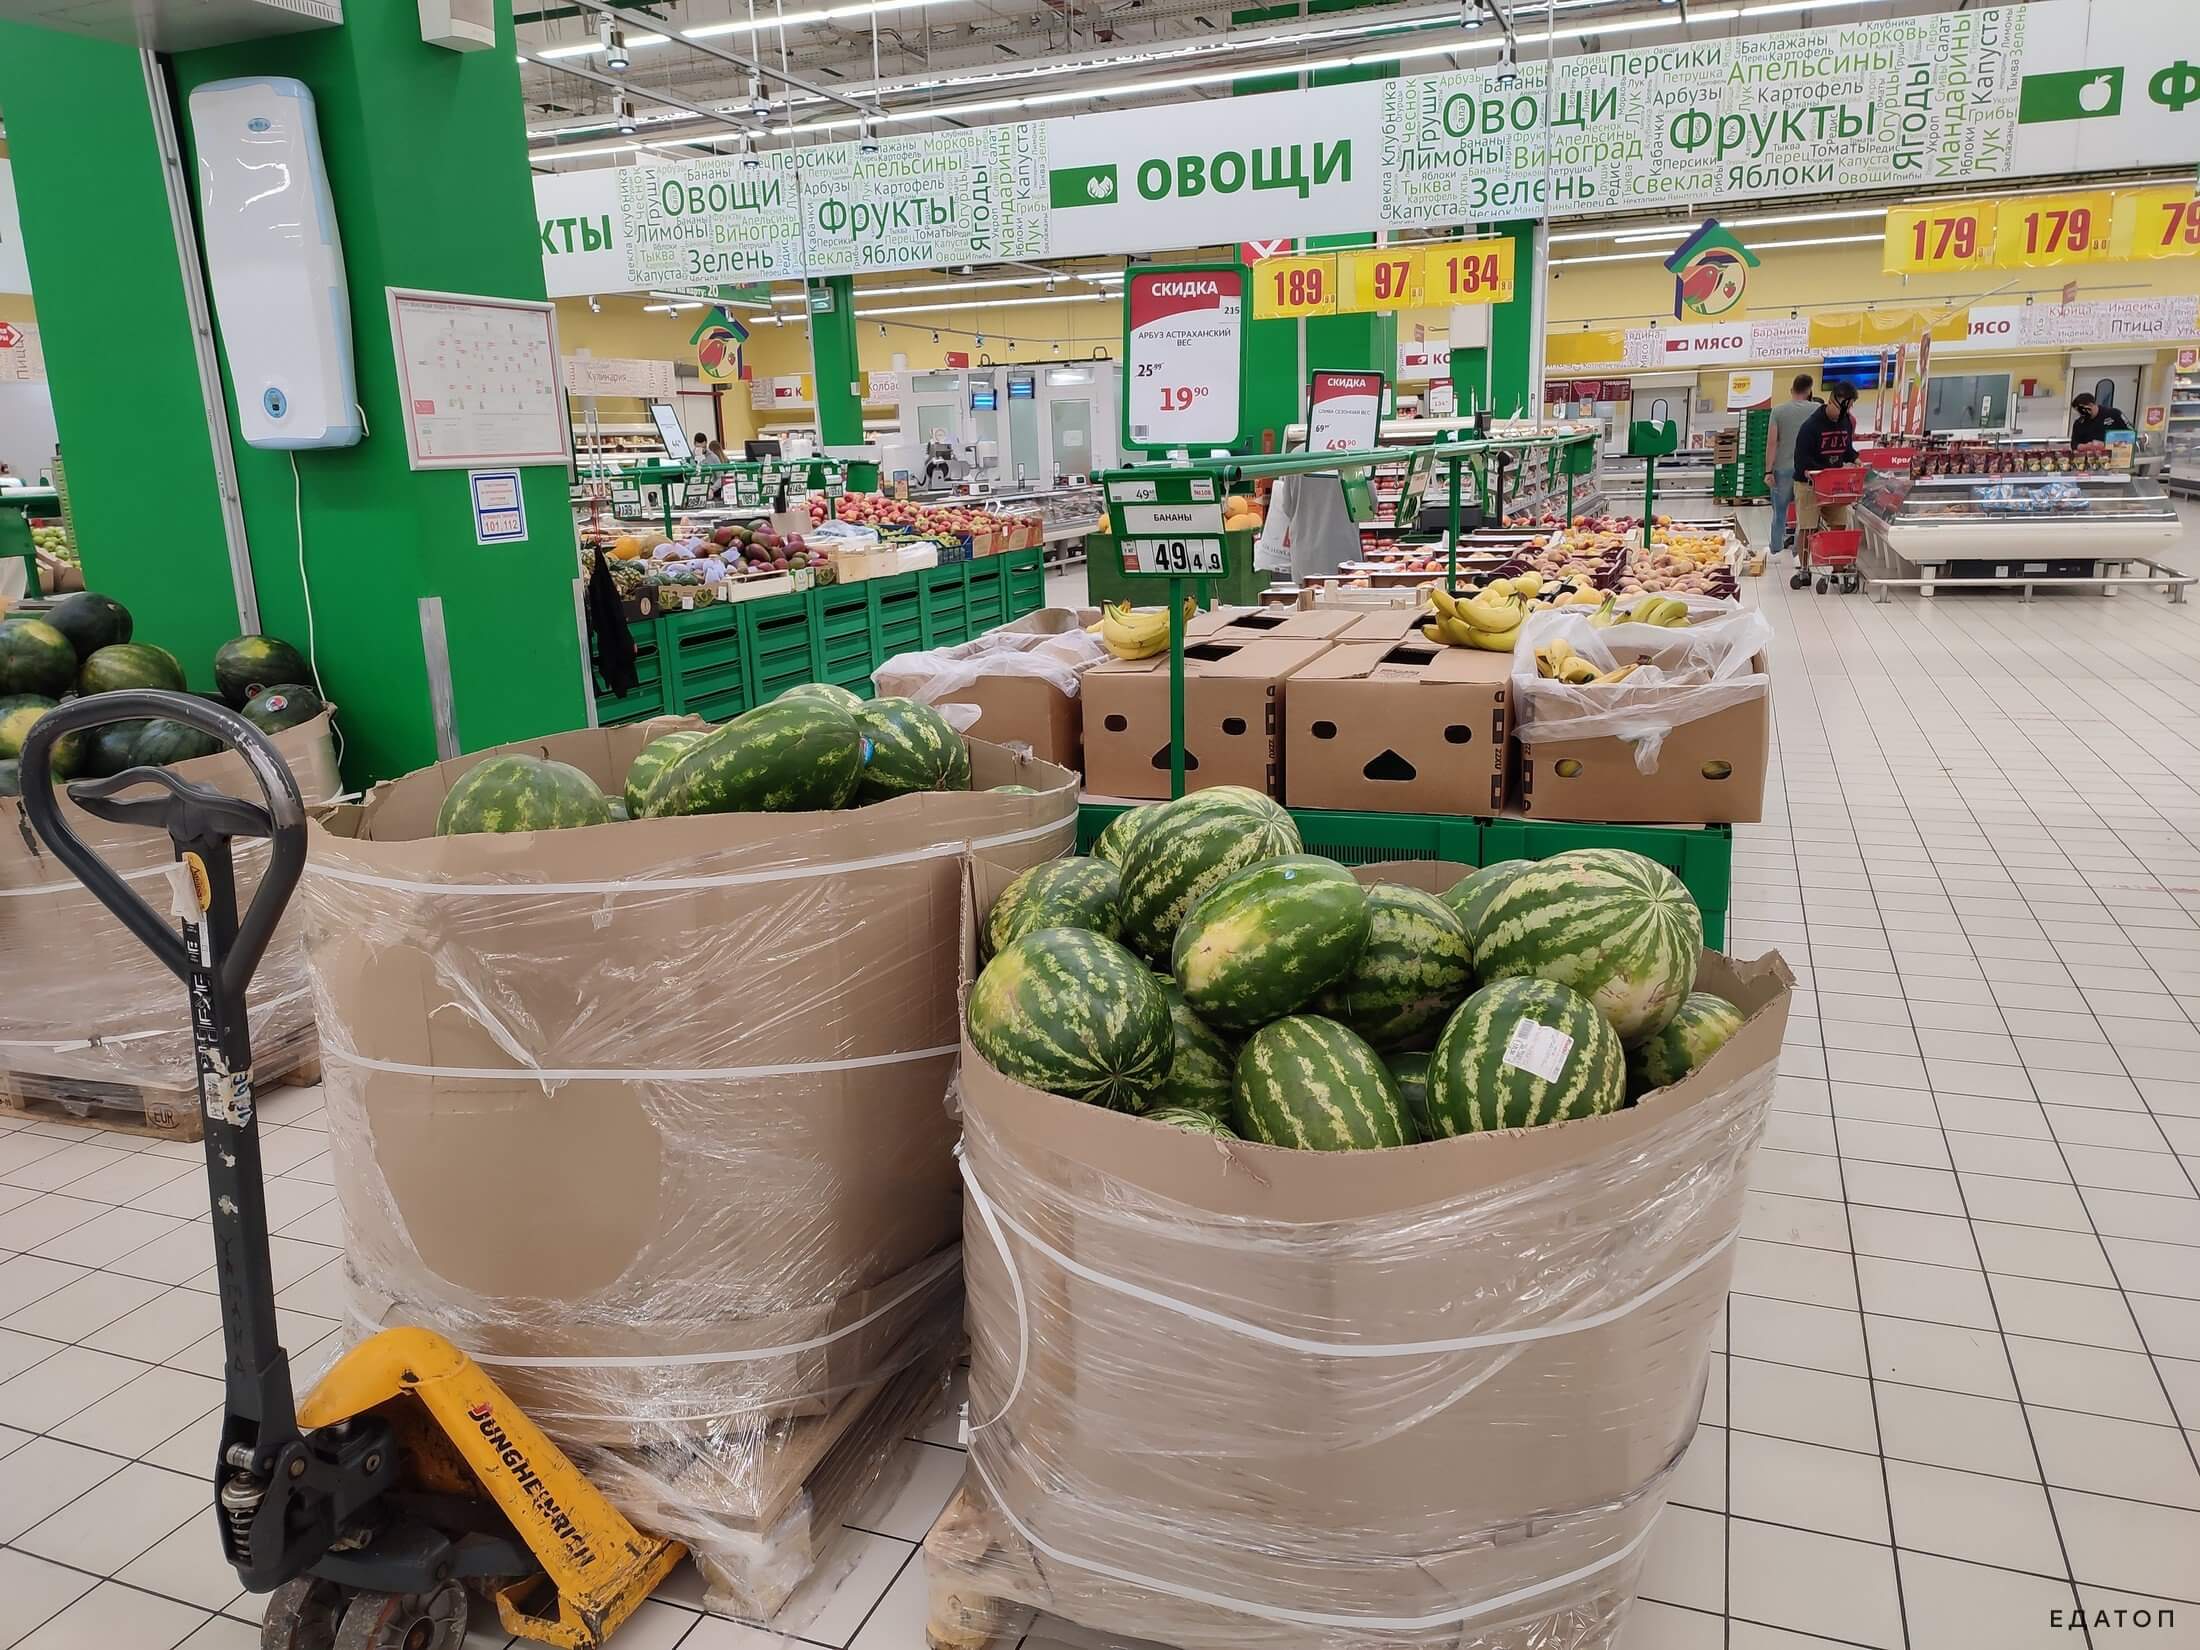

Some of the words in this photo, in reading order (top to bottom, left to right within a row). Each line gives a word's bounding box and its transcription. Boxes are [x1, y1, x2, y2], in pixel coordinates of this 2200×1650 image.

[1866, 18, 1916, 31] Клубника
[2001, 8, 2013, 48] Лимоны
[2010, 5, 2027, 56] Зелень
[1741, 35, 1828, 54] Баклажаны
[1839, 27, 1928, 48] Морковь
[1934, 17, 1950, 63] Салат
[1610, 48, 1721, 79] Персики
[1768, 47, 1834, 62] Картофель
[1971, 9, 2002, 105] Капуста
[1440, 73, 1484, 88] Арбузы
[1561, 63, 1608, 79] Перец
[1663, 68, 1723, 84] Петрушка
[1727, 50, 1894, 86] Апельсины
[2007, 58, 2020, 92] Тыква
[1483, 74, 1547, 94] Бананы
[1628, 78, 1645, 89] Лук
[1758, 80, 1864, 105] Картофель
[1935, 13, 1972, 177] Мандарины
[1625, 91, 1645, 125] Лук
[1653, 86, 1722, 109] Арбузы
[1739, 86, 1755, 112] Лук
[1878, 70, 1901, 143] Огурцы
[1382, 81, 1399, 166] Клубника
[1402, 79, 1417, 143] Чеснок
[1418, 80, 1440, 150] Груши
[1443, 86, 1617, 137] Овощи
[1893, 62, 1934, 170] Ягоды
[1968, 106, 2018, 125] Грибы
[1555, 130, 1636, 148] Апельсины
[1585, 122, 1623, 133] Чеснок
[1669, 101, 1875, 161] Фрукты
[1827, 112, 1838, 145] Редис
[1926, 115, 1940, 154] Укроп
[924, 135, 982, 153] Морковь
[989, 128, 998, 166] Салат
[1460, 136, 1505, 149] Бананы
[1514, 139, 1643, 170] Виноград
[1650, 113, 1665, 177] Кабачки
[1773, 142, 1801, 152] Тыква
[1810, 142, 1870, 158] Томаты
[1959, 126, 1976, 176] Яблоки
[1975, 127, 2005, 173] Лук
[771, 149, 846, 170] Персики
[853, 155, 962, 180] Апельсины
[878, 151, 922, 161] Картофель
[1016, 123, 1032, 200] Капуста
[1398, 145, 1504, 172] Лимоны
[1663, 156, 1717, 171] Персики
[1765, 151, 1810, 166] Перец
[1838, 155, 1890, 168] Капуста
[687, 167, 731, 181] Бананы
[1136, 138, 1352, 201] ОВОЩИ
[1421, 170, 1457, 181] Яблоки
[1713, 164, 1723, 197] Грибы
[1727, 163, 1834, 191] Яблоки
[1838, 170, 1892, 185] Овощи
[804, 181, 850, 198] Арбузы
[874, 179, 945, 196] Картофель
[998, 126, 1016, 258] Мандарины
[1380, 171, 1392, 220] Свекла
[1401, 179, 1451, 195] Тыква
[1470, 175, 1595, 208] Зелень
[1606, 160, 1621, 206] Редис
[1632, 172, 1713, 195] Свекла
[619, 168, 633, 238] Клубника
[645, 169, 663, 226] Груши
[662, 178, 781, 217] Овощи
[959, 170, 971, 229] Огурцы
[970, 165, 992, 251] Ягоды
[1016, 202, 1049, 217] Грибы
[819, 195, 955, 242] Фрукты
[992, 207, 1000, 239] Укроп
[1392, 202, 1458, 221] Капуста
[541, 215, 614, 255] КТЫ
[636, 223, 708, 243] Лимоны
[715, 222, 801, 243] Виноград
[808, 202, 818, 252] Кабачки
[914, 228, 954, 241] Томаты
[1016, 217, 1024, 257] Яблоки
[1025, 218, 1043, 255] Лук
[1913, 216, 1977, 261] 179
[2024, 208, 2091, 254] 179
[817, 237, 853, 248] Персики
[863, 243, 932, 265] Яблоки
[640, 249, 675, 262] Тыква
[688, 248, 774, 275] Зелень
[782, 239, 791, 275] Редис
[799, 249, 853, 266] Свекла
[635, 269, 682, 283] Капуста
[1375, 261, 1410, 300] 97
[1446, 254, 1499, 294] 134
[1151, 280, 1219, 298] СКИДКА
[1273, 268, 1322, 306] 189
[1224, 306, 1240, 315] 215
[2049, 305, 2093, 318] Курица
[1138, 330, 1164, 340] АРБУЗ
[1166, 327, 1231, 339] АСТРАХАНСКИЙ
[1753, 326, 1807, 338] Баранина
[2111, 318, 2163, 334] Птица
[1176, 338, 1192, 347] ВЕС
[1694, 335, 1743, 351] МЯСО
[1756, 346, 1810, 358] Телятина
[1640, 343, 1649, 368] Мясо
[1327, 377, 1367, 389] СКИДКА
[1153, 513, 1193, 522] БАНАНЫ
[154, 1110, 175, 1125] EUR
